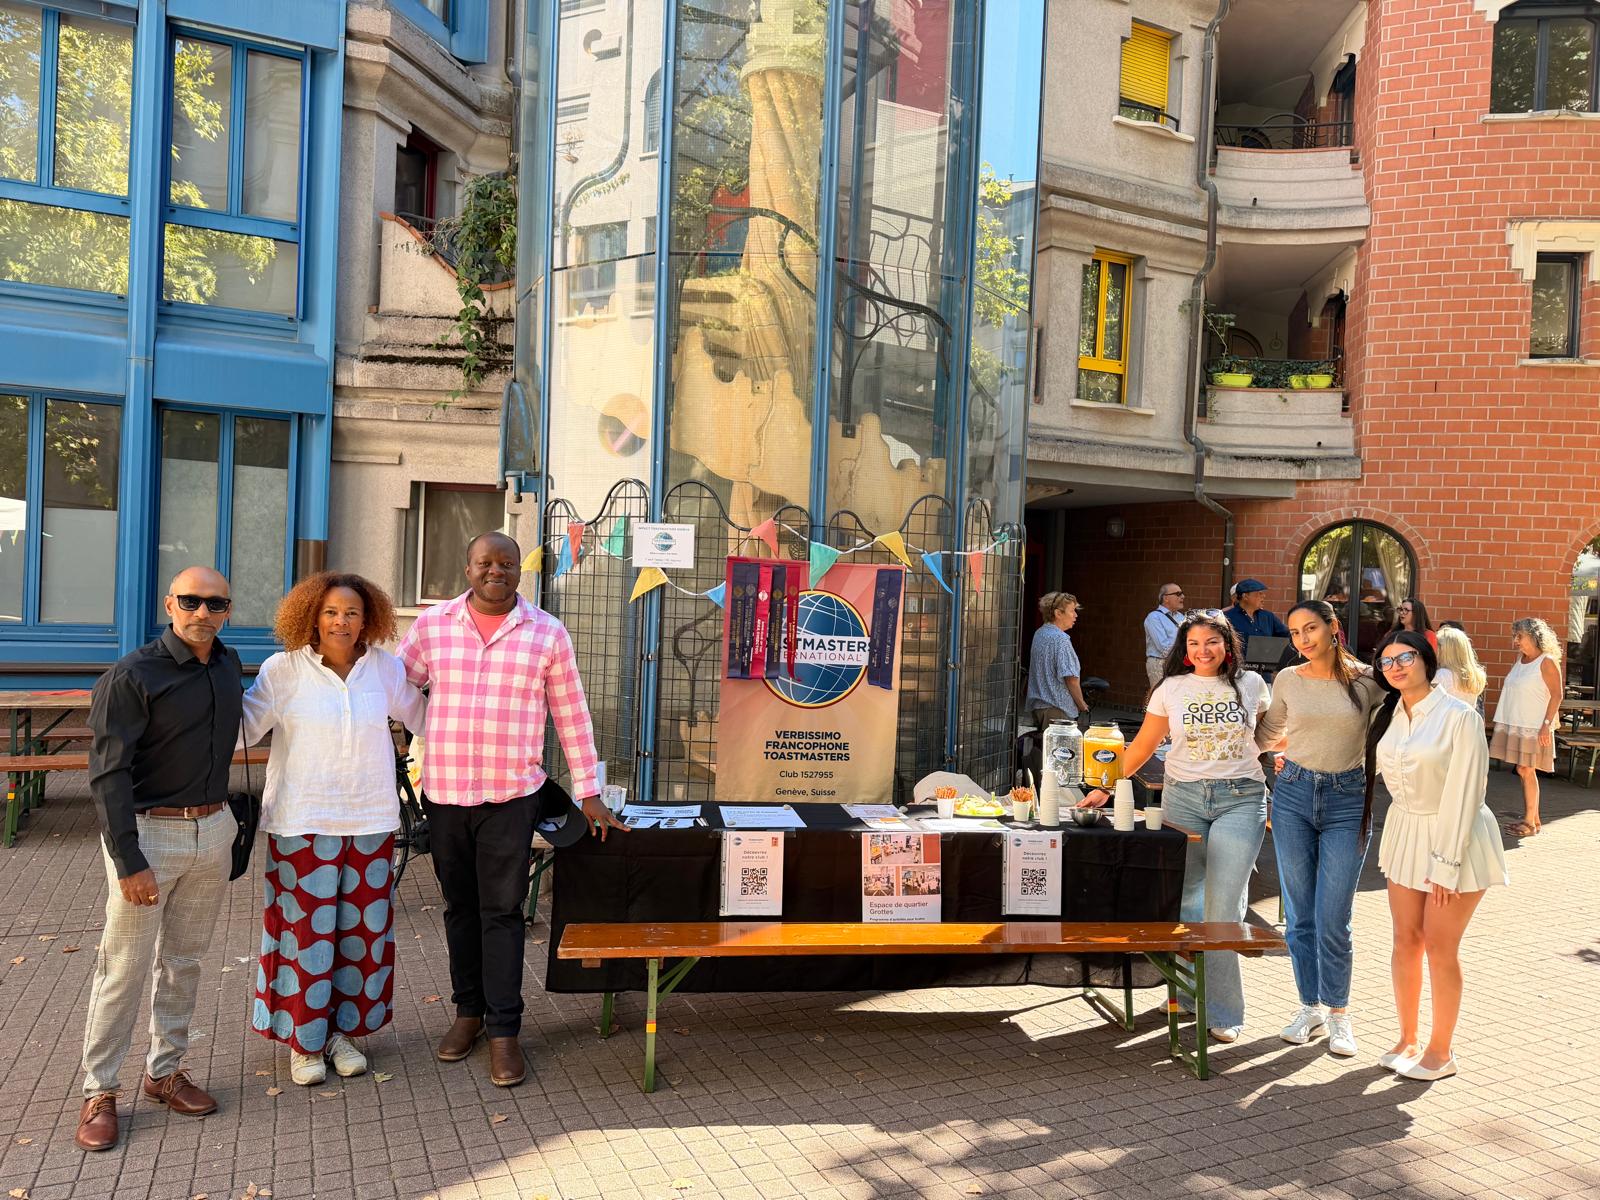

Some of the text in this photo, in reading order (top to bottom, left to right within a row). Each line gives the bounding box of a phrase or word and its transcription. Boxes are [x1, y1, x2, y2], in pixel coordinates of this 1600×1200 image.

[780, 637, 870, 652] STMASTER
[1188, 701, 1240, 714] GOOD
[1182, 711, 1246, 725] ENERGY
[775, 730, 841, 740] VERBISSIMO
[765, 741, 850, 751] FRANCOPHONE
[764, 751, 850, 761] TOASTMASTERS
[779, 770, 799, 778] Club
[775, 787, 836, 796] Genève, Suisse
